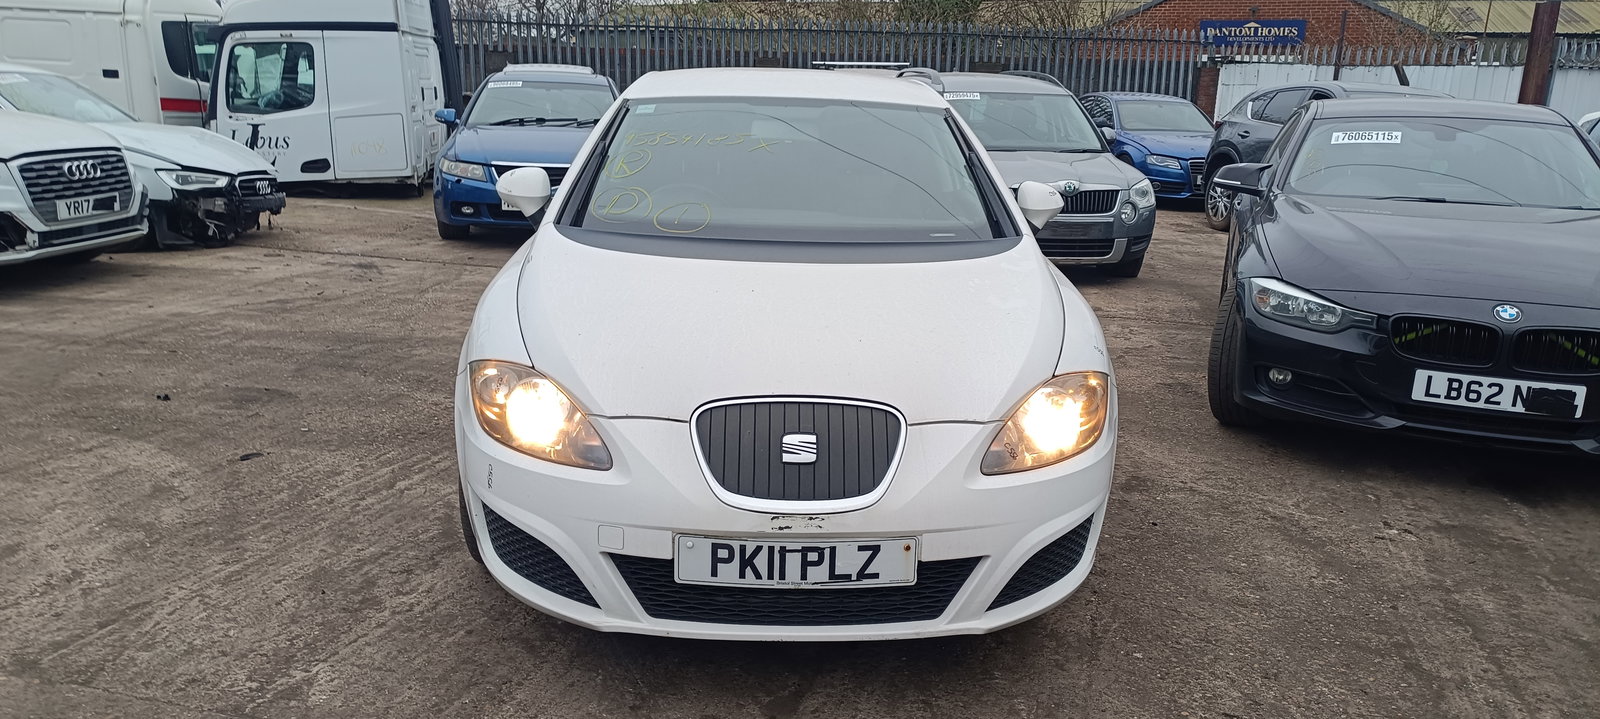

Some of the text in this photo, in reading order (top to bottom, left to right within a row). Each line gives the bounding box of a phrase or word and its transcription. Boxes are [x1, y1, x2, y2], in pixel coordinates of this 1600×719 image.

[1206, 27, 1298, 36] DANTOM HOMES
[65, 199, 91, 216] YR17
[1424, 375, 1504, 406] LB62
